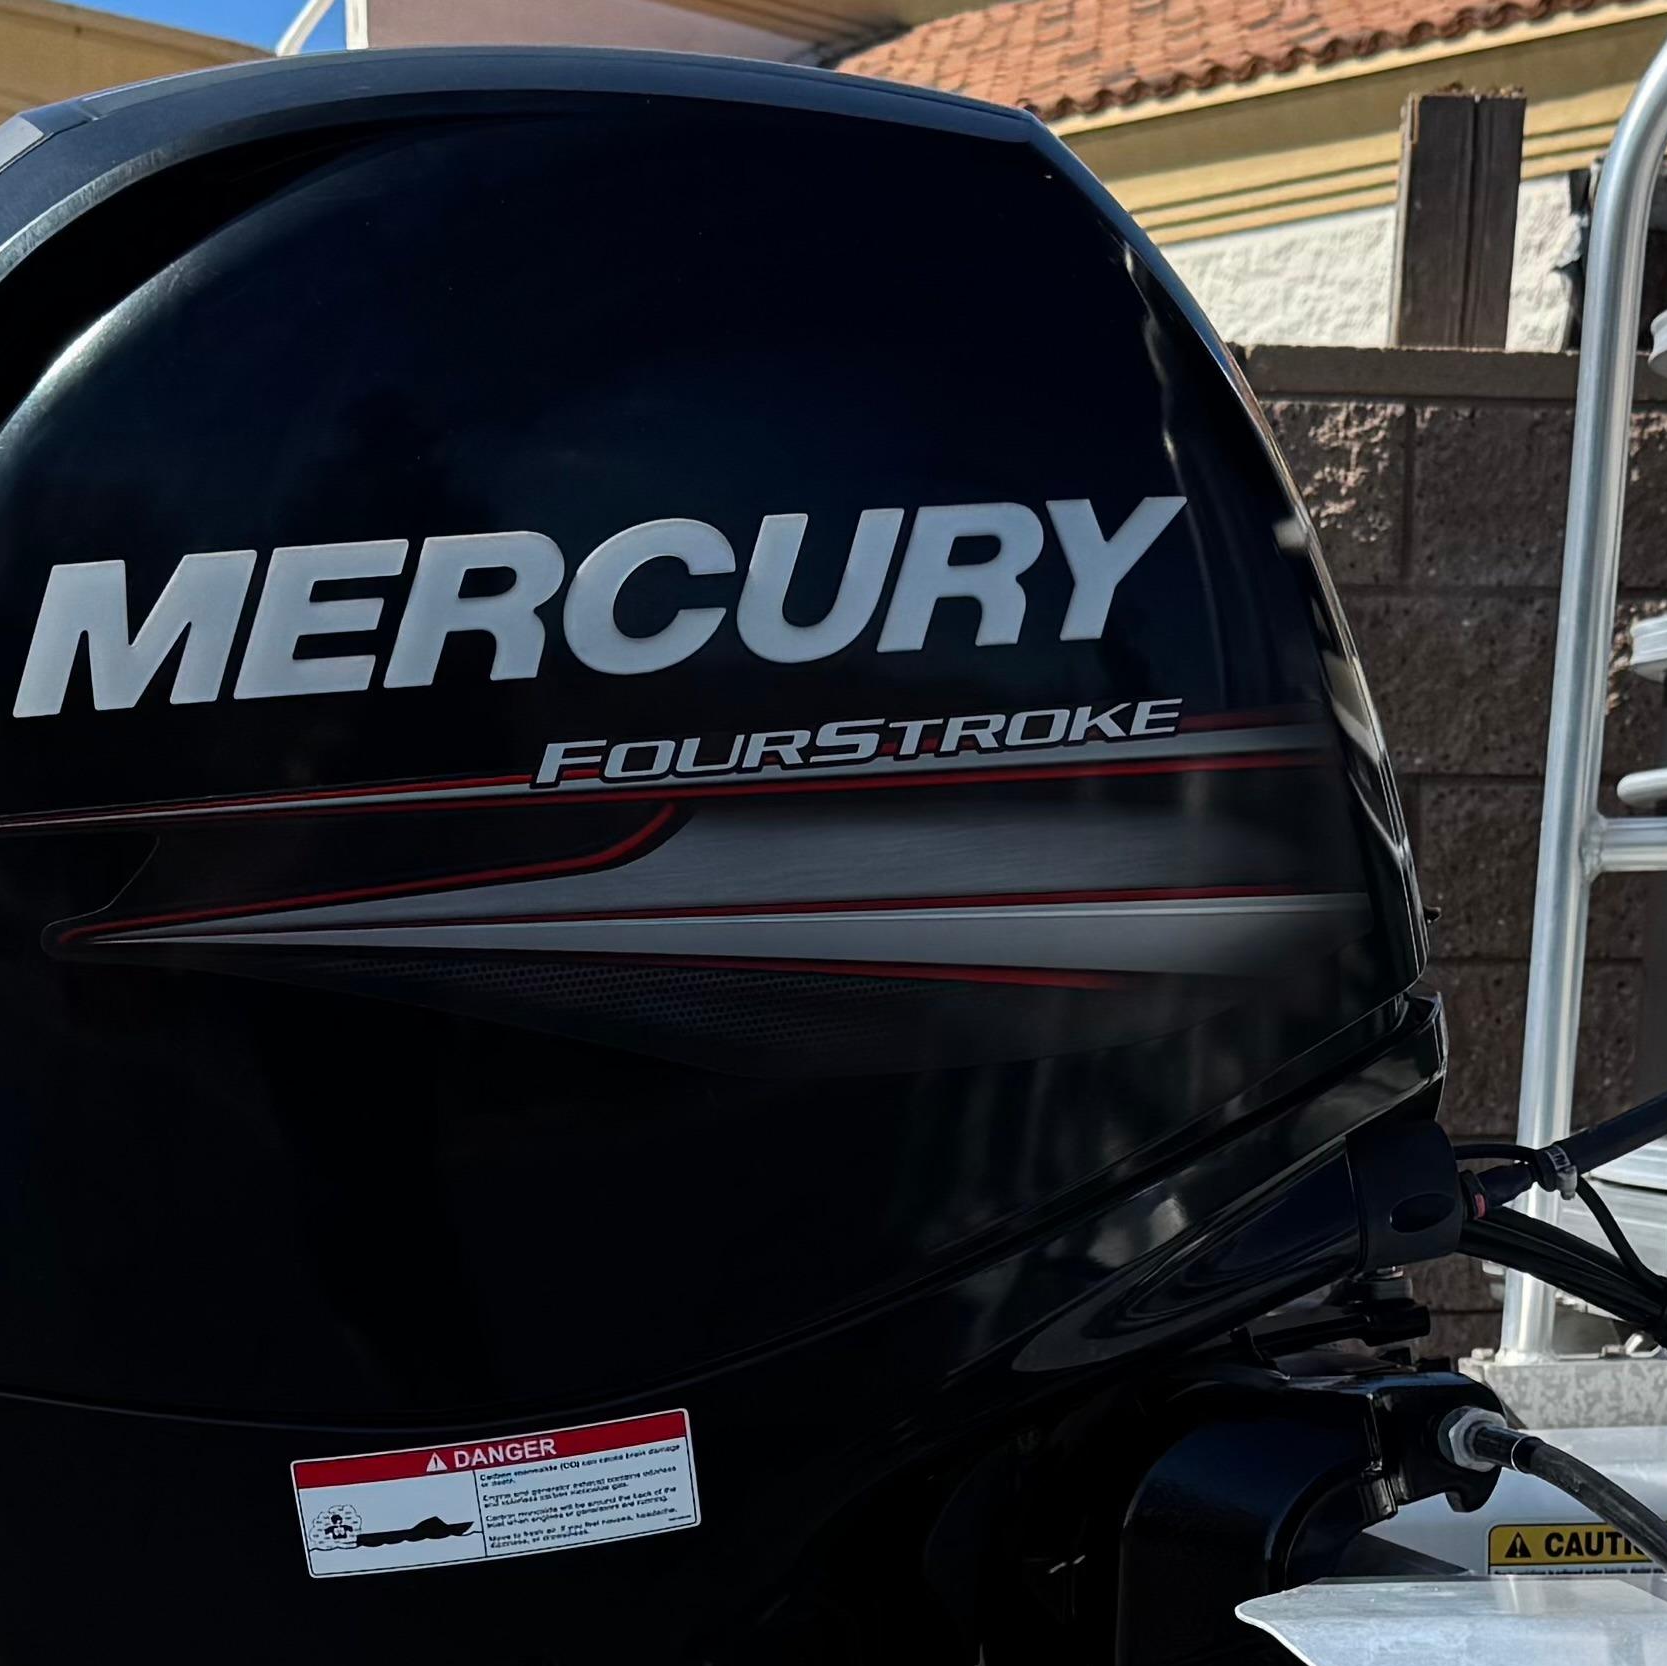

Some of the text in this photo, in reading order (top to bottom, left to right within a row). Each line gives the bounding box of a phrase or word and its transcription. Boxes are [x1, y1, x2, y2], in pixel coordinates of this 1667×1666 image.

[12, 496, 1187, 718] MERCURY
[533, 697, 1185, 785] FOURSTROKE
[454, 1438, 557, 1468] DANGER
[1545, 1532, 1645, 1557] CAUTI
